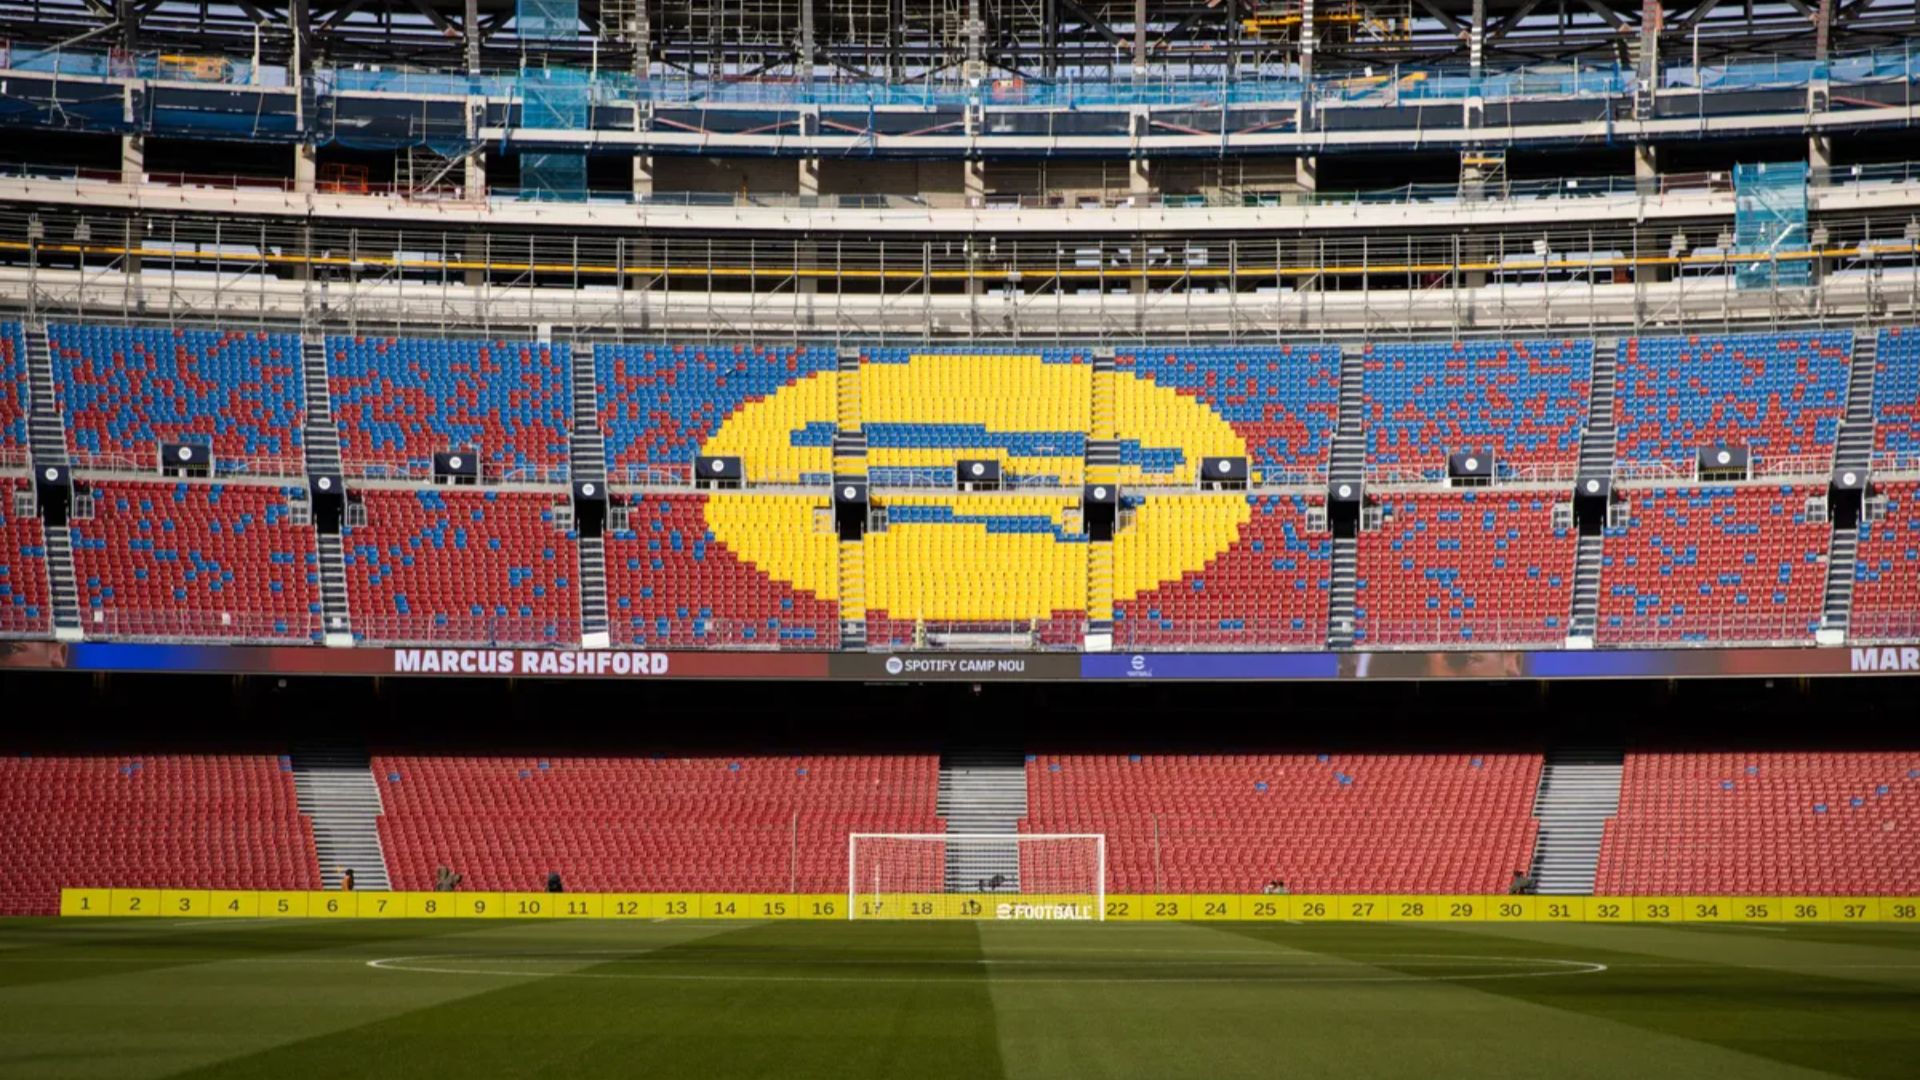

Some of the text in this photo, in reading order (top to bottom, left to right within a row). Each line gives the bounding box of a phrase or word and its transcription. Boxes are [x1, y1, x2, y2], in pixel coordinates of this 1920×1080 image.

[394, 649, 670, 675] MARCUS RASHFORD
[904, 659, 1025, 673] SPOTIFY CAMP NOU
[81, 896, 90, 911] 1
[129, 897, 141, 911] 2
[179, 897, 191, 912] 3
[228, 898, 240, 912] 4
[277, 899, 289, 913] 5
[326, 899, 339, 913] 6
[378, 899, 388, 913] 7
[425, 899, 437, 913] 8
[474, 900, 486, 914] 9
[518, 900, 541, 914] 10
[568, 901, 588, 915] 11
[617, 901, 638, 915] 12
[666, 901, 688, 915] 13
[715, 901, 736, 915] 14
[764, 902, 786, 916] 15
[813, 902, 835, 916] 16
[911, 902, 933, 915] 18
[960, 901, 982, 916] 19
[1106, 902, 1129, 917] 22
[1155, 902, 1179, 916] 23
[1204, 902, 1227, 916] 24
[1254, 902, 1277, 916] 25
[1303, 902, 1326, 917] 26
[1352, 903, 1375, 917] 27
[1401, 902, 1424, 917] 28
[1450, 903, 1473, 917] 29
[1499, 903, 1523, 917] 30
[1549, 904, 1571, 918] 31
[1598, 904, 1620, 918] 32
[1647, 904, 1670, 918] 33
[1696, 904, 1719, 918] 34
[1745, 904, 1769, 918] 35
[1794, 904, 1818, 919] 36
[1844, 904, 1867, 918] 37
[1893, 904, 1917, 919] 38
